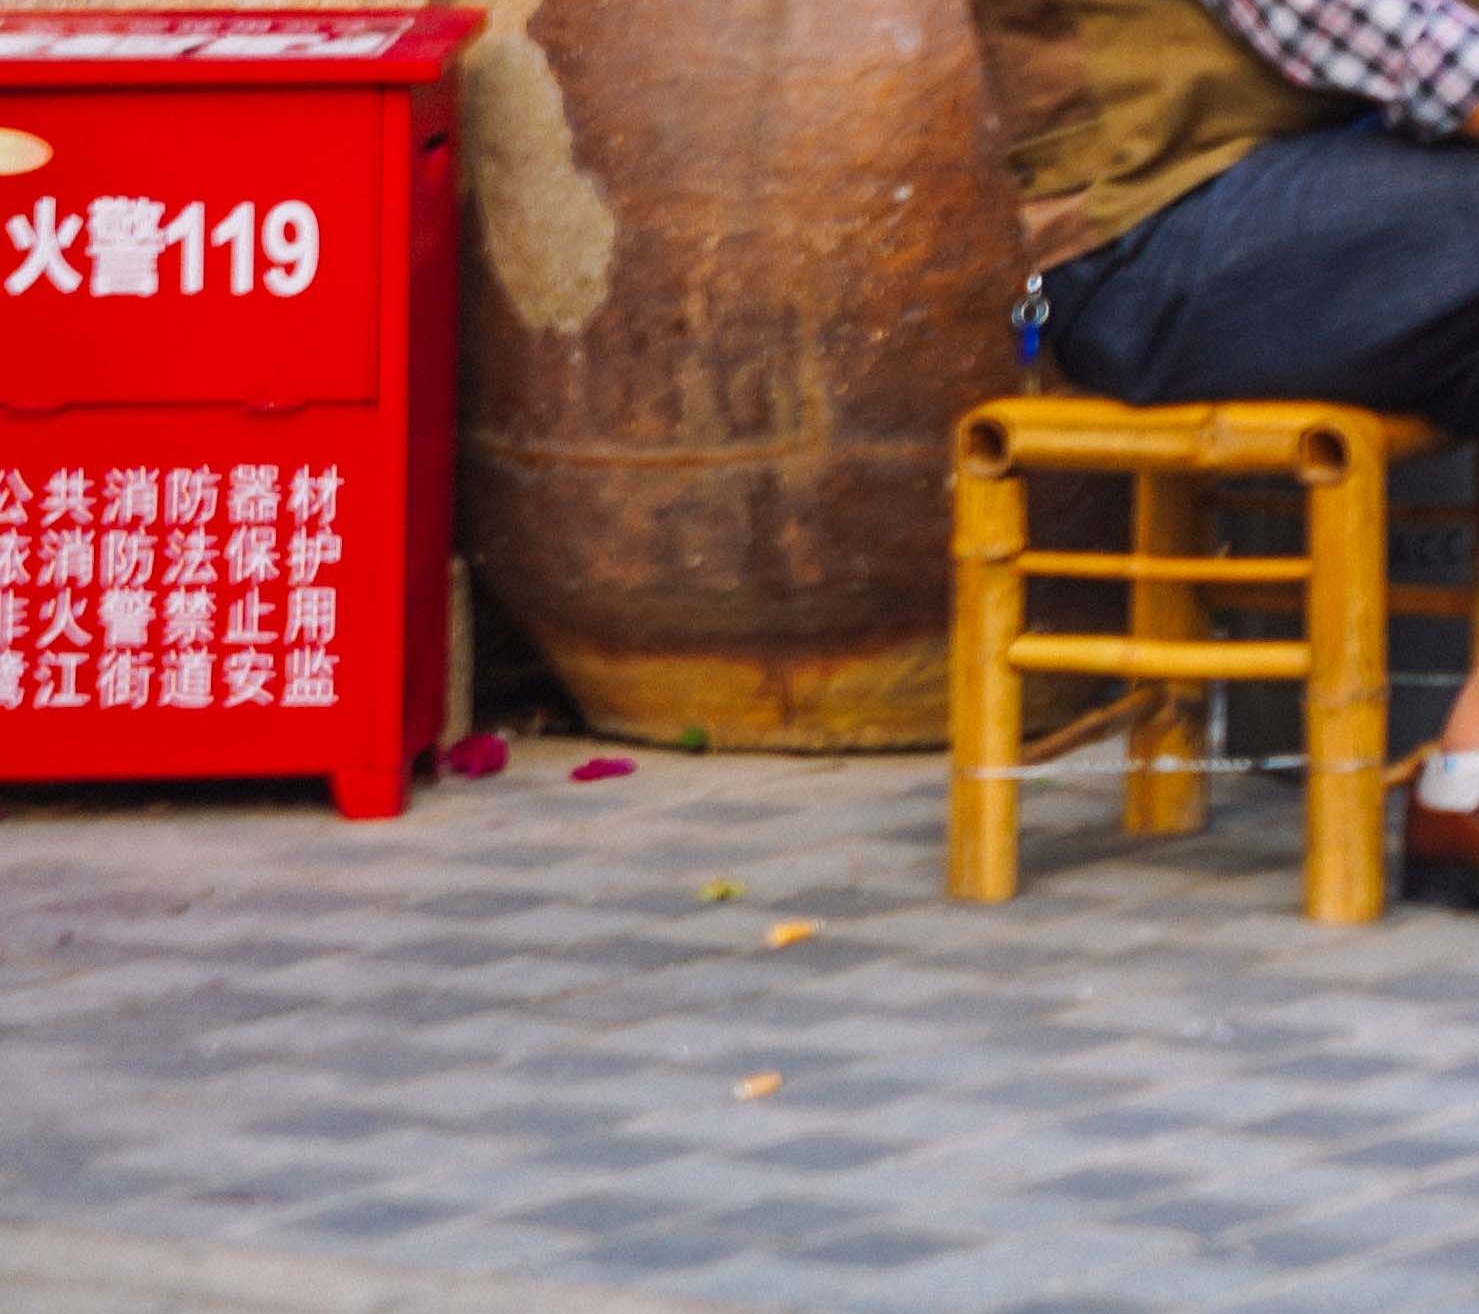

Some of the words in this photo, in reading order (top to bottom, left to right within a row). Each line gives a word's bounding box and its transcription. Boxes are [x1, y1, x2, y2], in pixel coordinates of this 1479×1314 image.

[4, 195, 321, 298] 火警119
[0, 463, 345, 527] 公共消防器材
[0, 524, 343, 588] 依消防法保护
